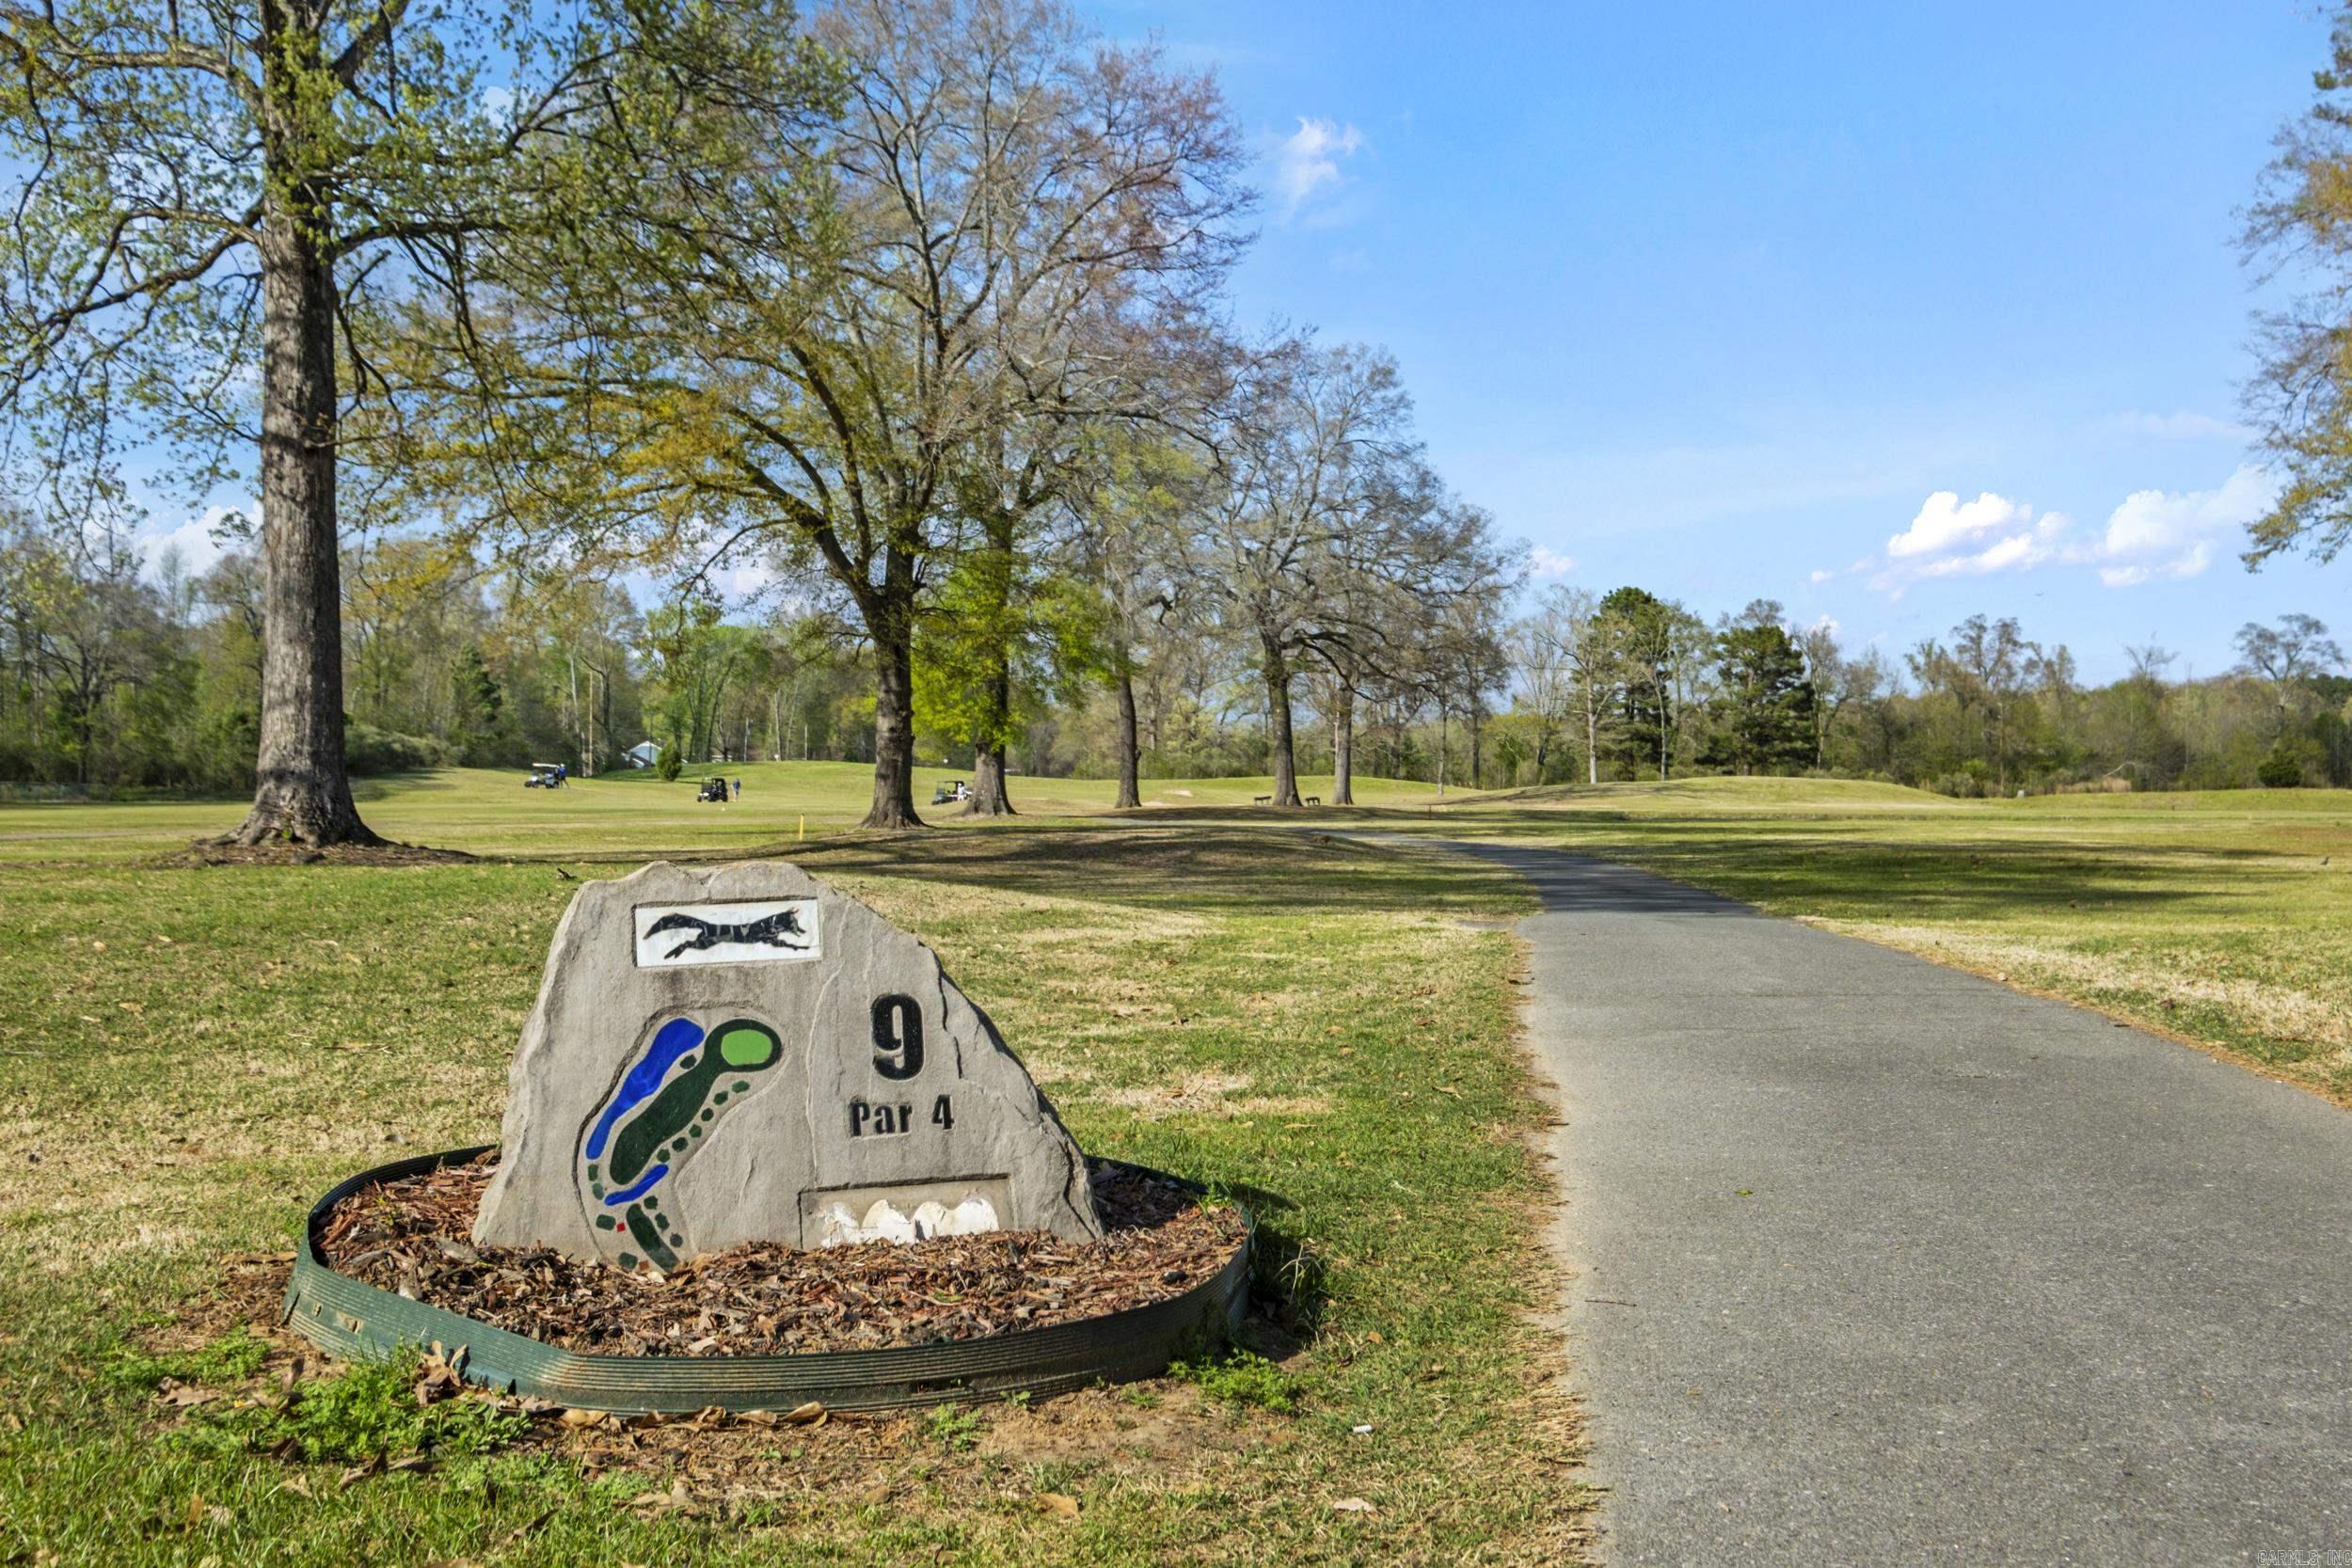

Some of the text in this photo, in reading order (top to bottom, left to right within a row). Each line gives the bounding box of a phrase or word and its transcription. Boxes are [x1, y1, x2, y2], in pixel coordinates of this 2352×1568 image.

[871, 993, 924, 1082] 9
[850, 1094, 955, 1137] Par 4
